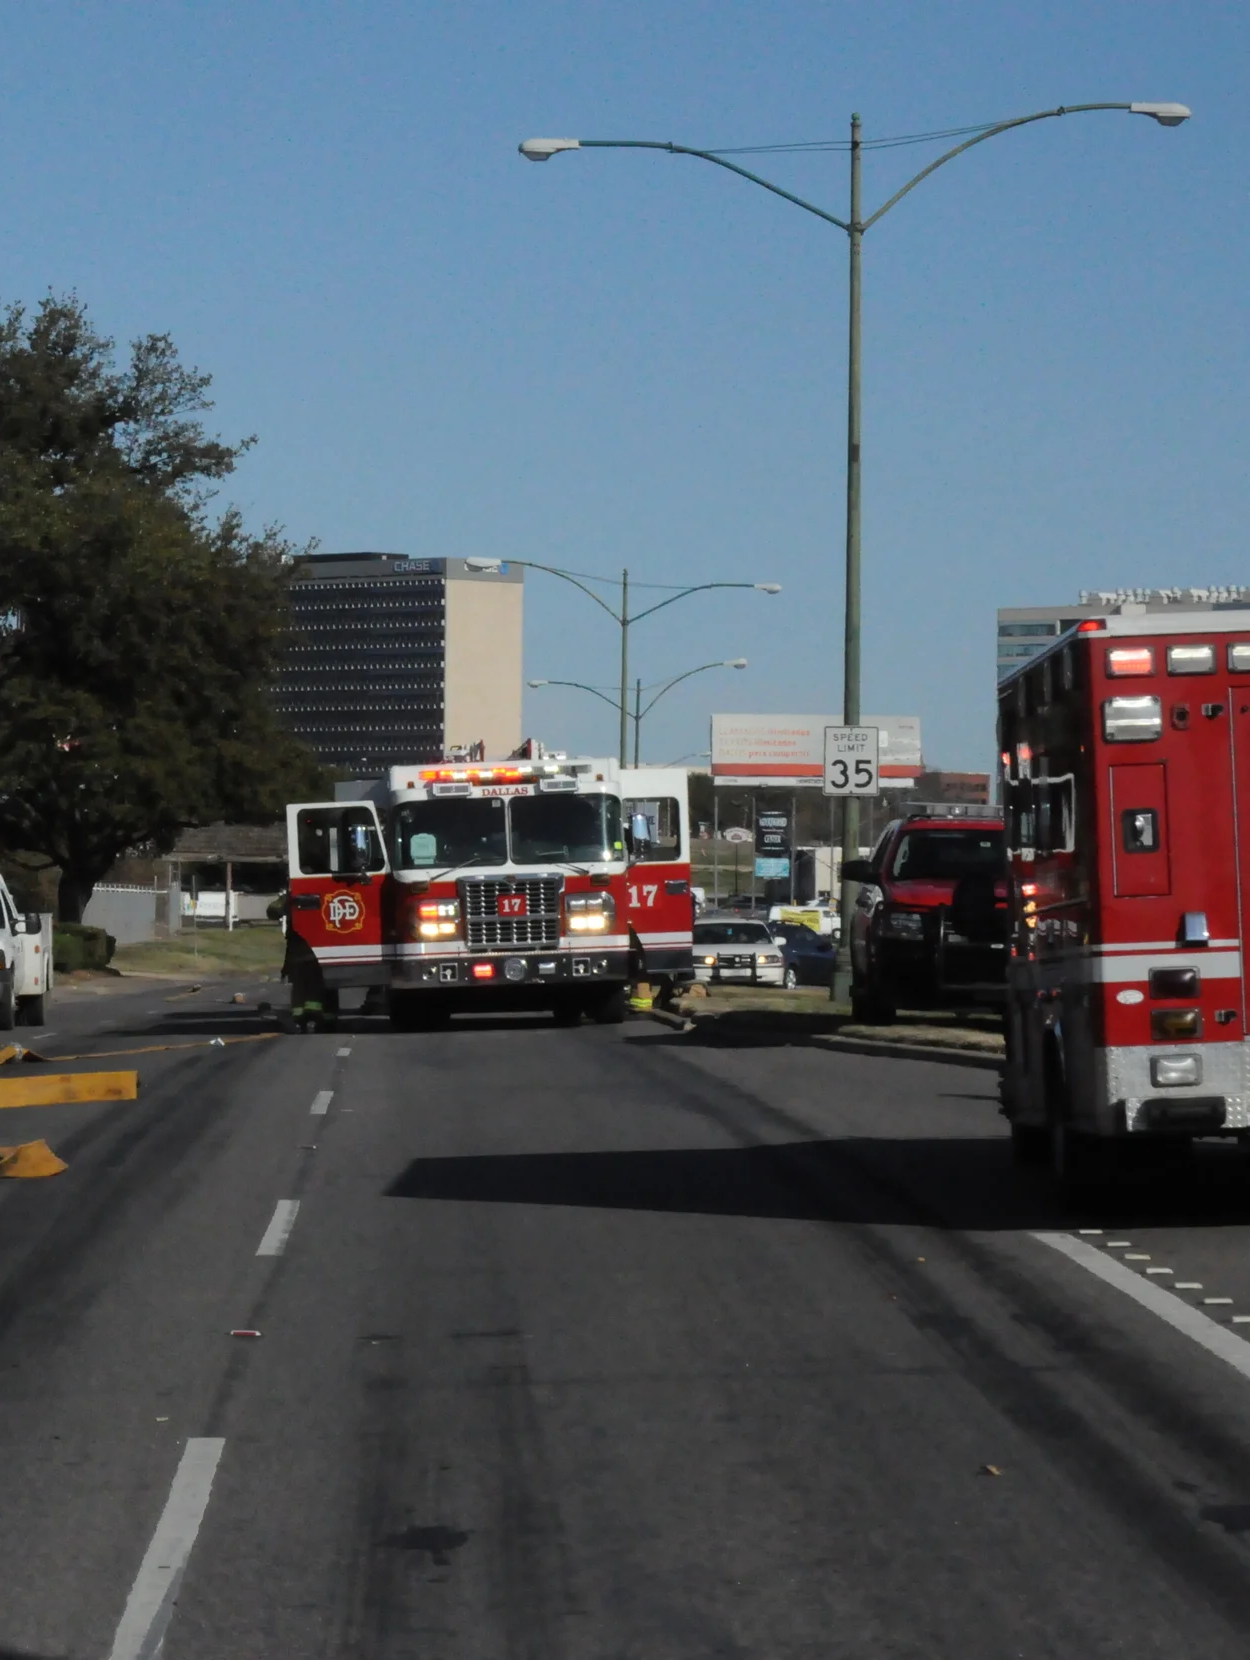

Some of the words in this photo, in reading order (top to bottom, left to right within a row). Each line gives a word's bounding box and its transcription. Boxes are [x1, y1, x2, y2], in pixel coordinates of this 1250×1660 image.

[394, 560, 430, 572] CHASE
[833, 733, 868, 741] SPEED
[837, 744, 865, 752] LIMIT
[830, 759, 873, 789] 35
[482, 786, 529, 797] DALLAS
[628, 884, 659, 908] 17
[502, 899, 522, 913] 17
